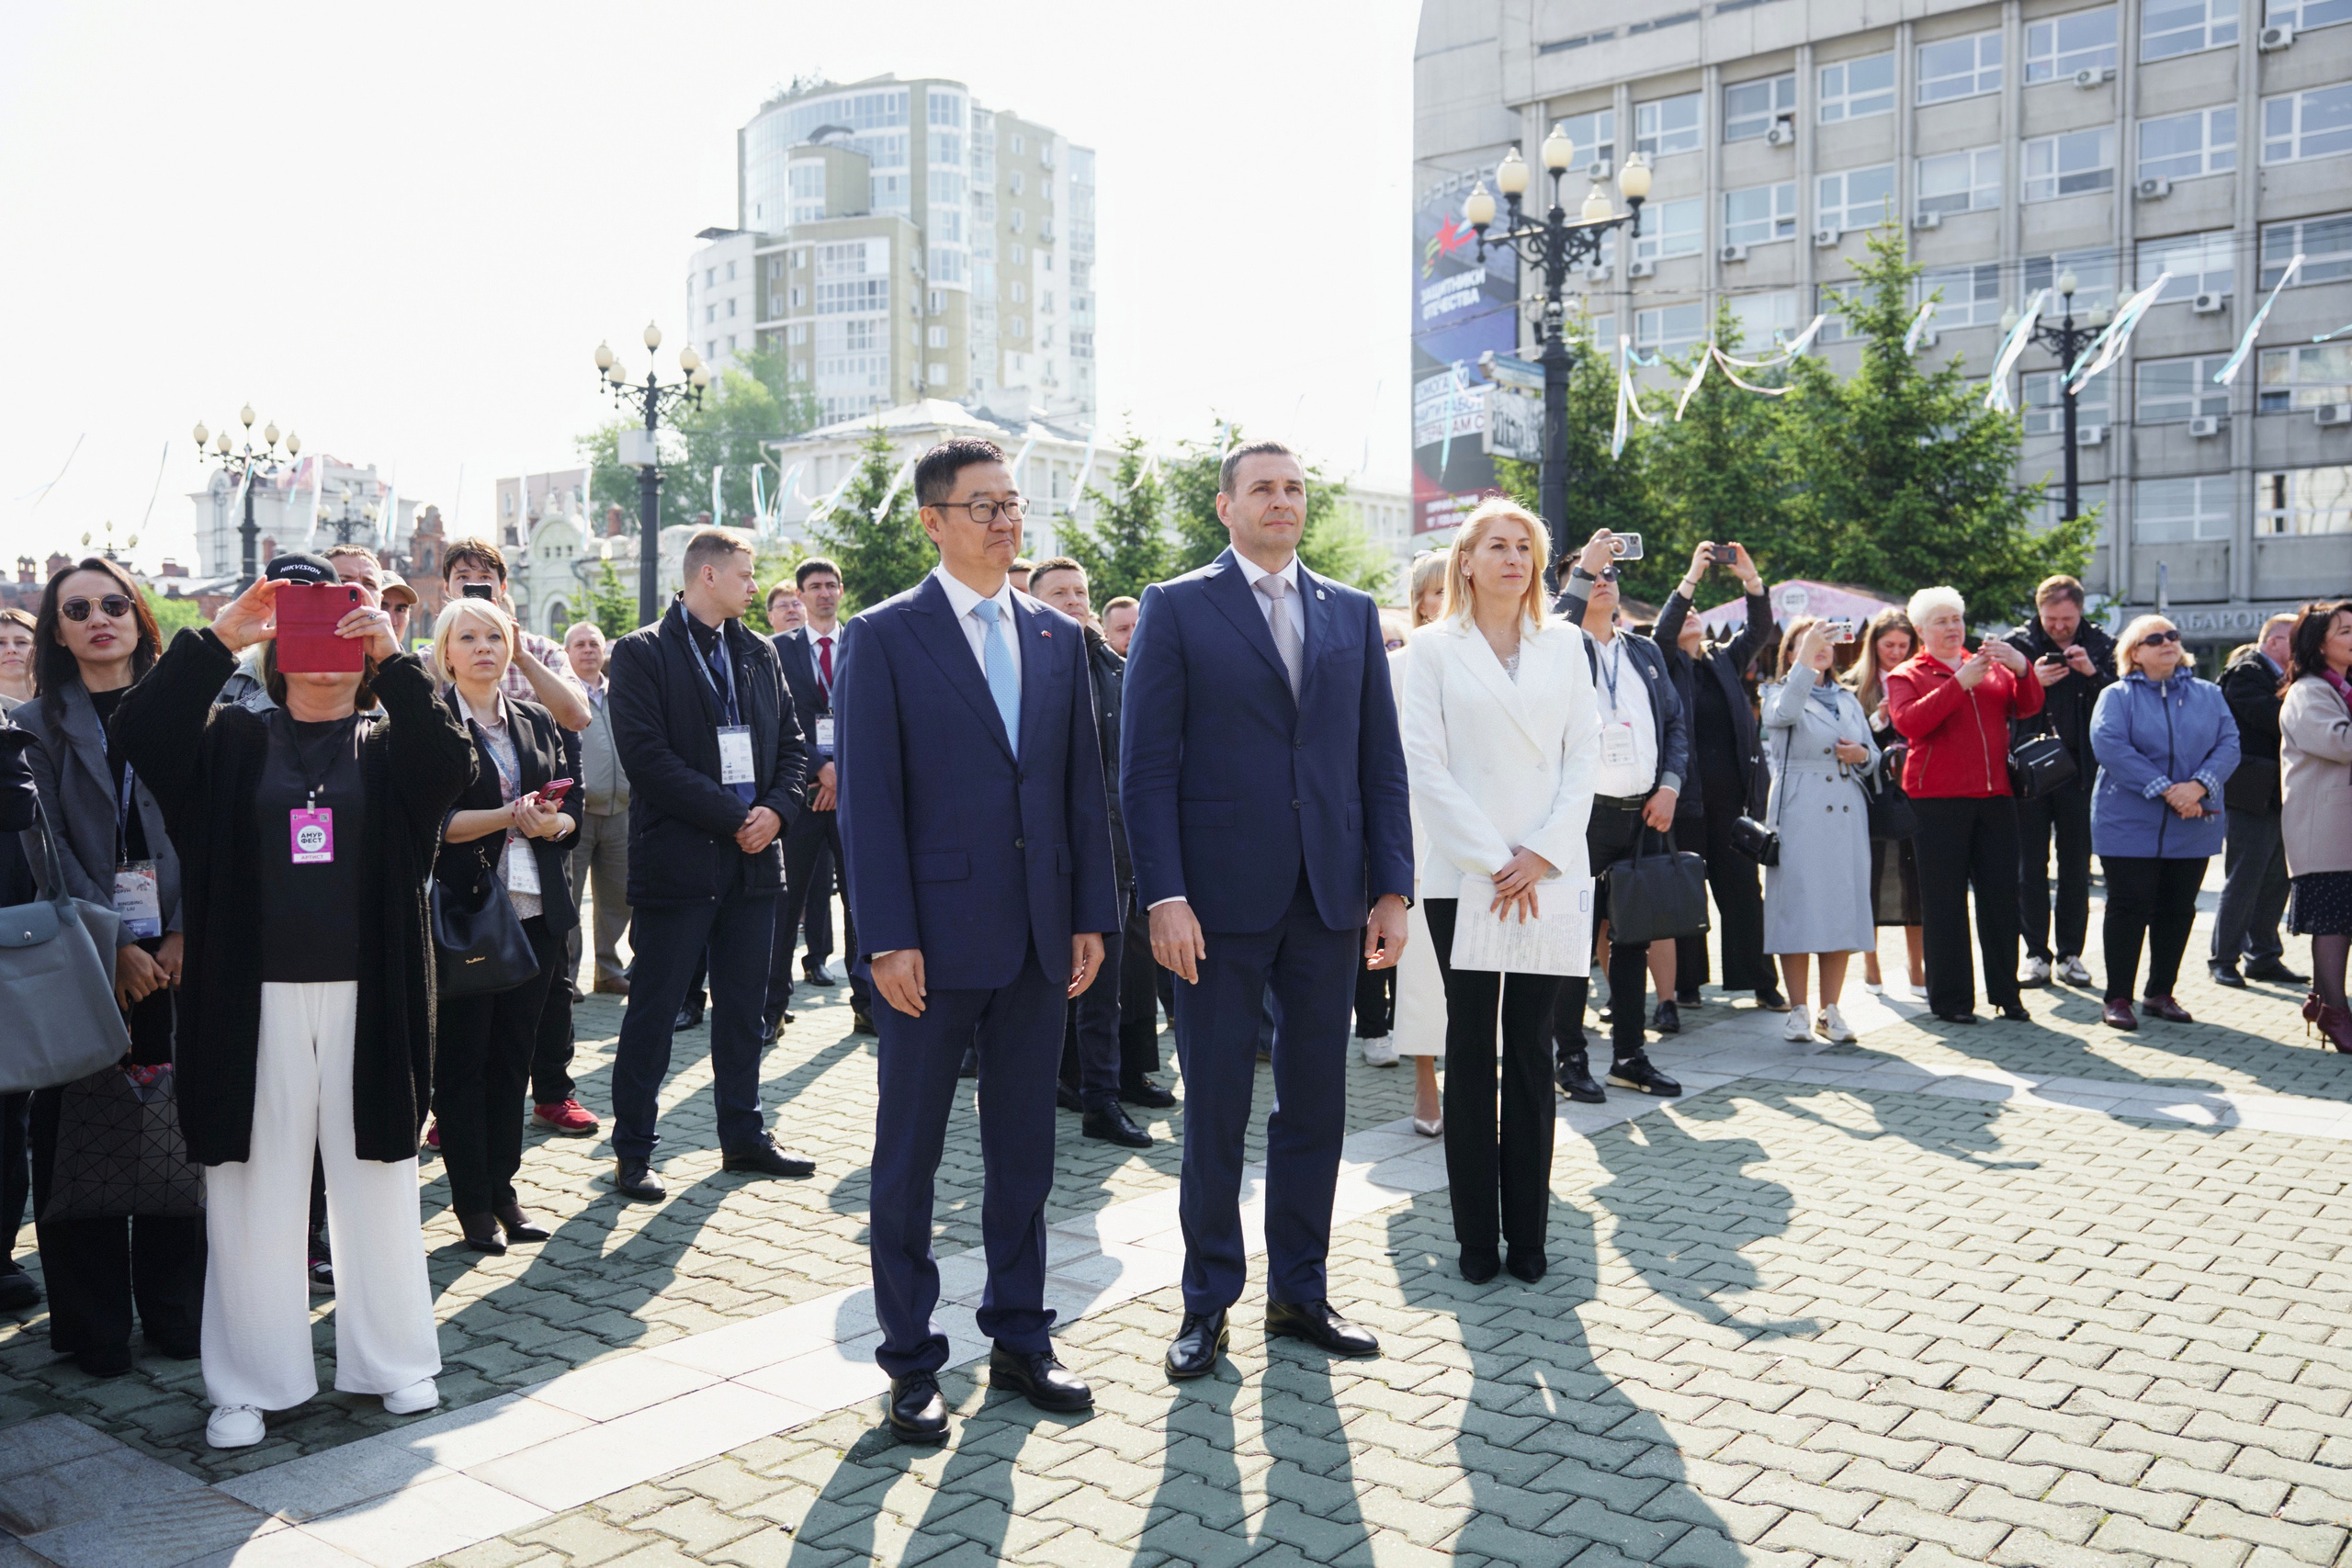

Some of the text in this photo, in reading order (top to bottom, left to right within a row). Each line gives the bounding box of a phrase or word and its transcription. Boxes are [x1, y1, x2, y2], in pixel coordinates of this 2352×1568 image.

[1420, 267, 1486, 305] ЗАЩИТНИКИ
[1423, 287, 1480, 321] ОТЕЧЕСТВА
[1416, 370, 1469, 401] ПОМОГАМ
[280, 564, 321, 575] HIKVISION
